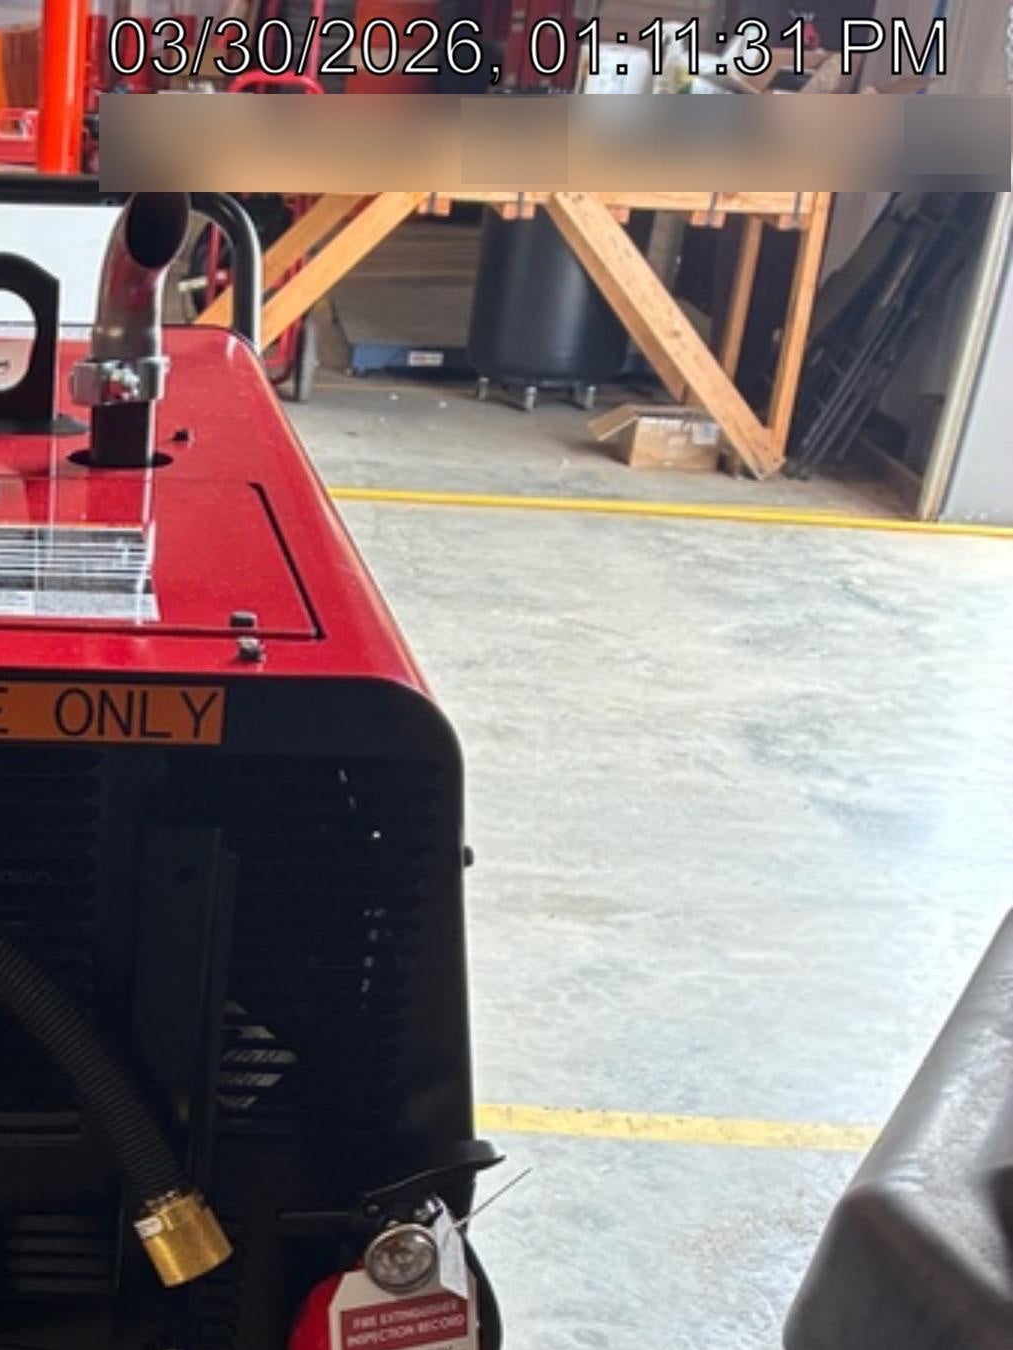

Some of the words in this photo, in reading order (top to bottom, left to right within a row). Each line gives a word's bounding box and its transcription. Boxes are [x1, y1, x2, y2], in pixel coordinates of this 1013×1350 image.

[54, 687, 219, 739] ONLY
[347, 1326, 414, 1347] INSPECTION
[417, 1312, 466, 1334] RECORD
[352, 1315, 376, 1329] FIRE
[379, 1300, 457, 1325] EXTINGUISHER
